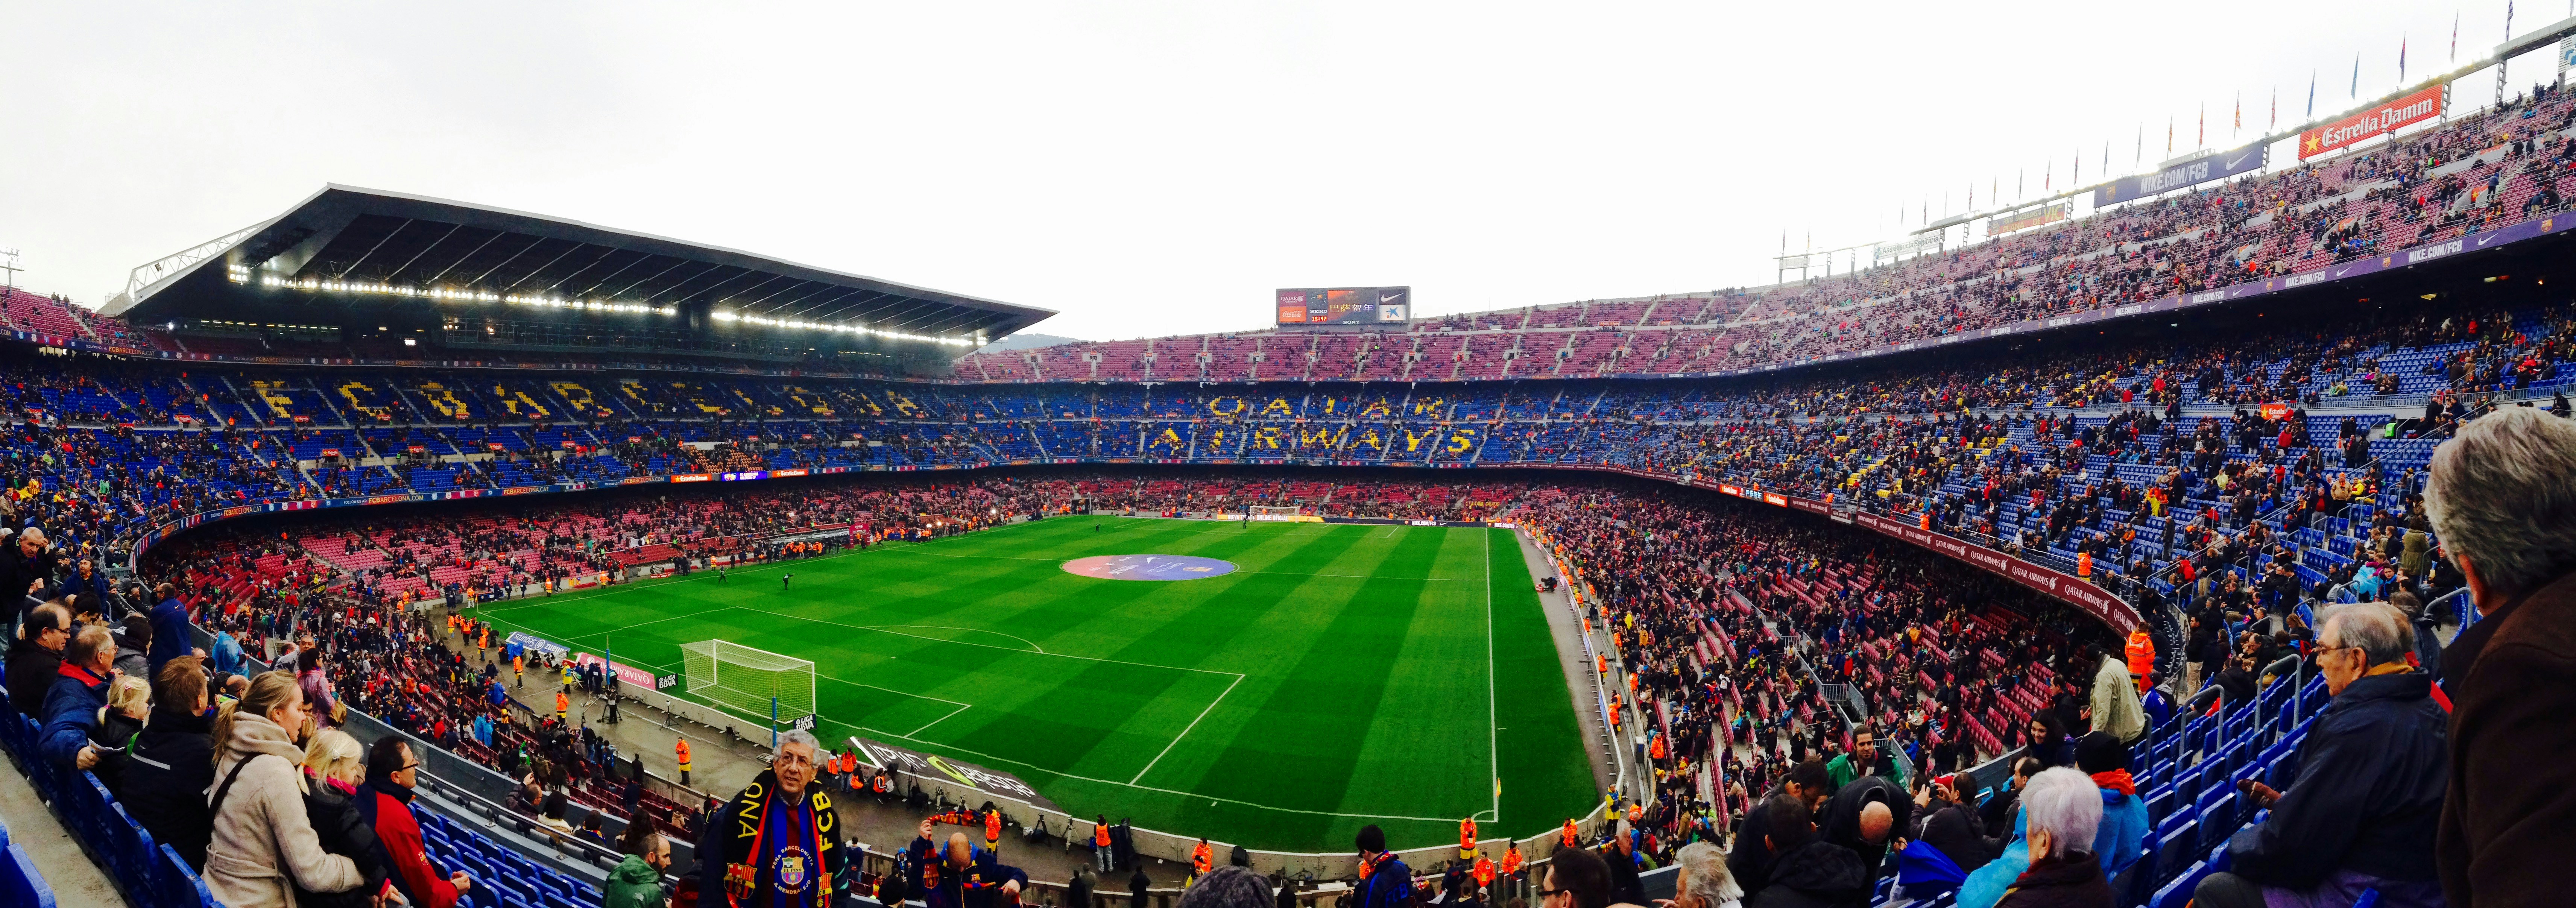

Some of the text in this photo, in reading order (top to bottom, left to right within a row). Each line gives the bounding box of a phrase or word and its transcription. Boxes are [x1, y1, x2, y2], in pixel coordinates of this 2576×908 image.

[2322, 98, 2433, 147] Estrella Damm
[2140, 161, 2208, 194] NIKE.COM/FCB
[2003, 222, 2024, 232] PLANA
[2044, 204, 2063, 222] VIC
[2409, 240, 2463, 263] NIKE.COM/FCB
[2285, 271, 2325, 287] NIKE.COM/FCB
[2193, 291, 2224, 303] NIKE.COM/FCB
[1331, 304, 1373, 312] 巴萨贺年
[2115, 306, 2142, 316] NIKE.COM/FCB
[2049, 317, 2071, 326] NIKE.COM/FCB
[109, 346, 155, 355] FCBARCELONA.CAT
[369, 495, 424, 504] FCBARCELONA.COM
[224, 506, 261, 516] FCBARCELONA.CAT
[1915, 533, 1926, 541] AIRWAYS
[1947, 543, 1960, 553] AIRWAYS
[1971, 551, 2000, 567] QATAR AIRWAYS
[2012, 566, 2049, 586] QATAR AIRWAYS
[2065, 584, 2103, 609] QATAR AIRWAYS
[2114, 609, 2125, 626] QATAR
[513, 634, 567, 653] llianz Seguros
[659, 679, 676, 689] BBVA
[796, 721, 814, 731] BBVA
[950, 764, 1035, 798] etisalat
[738, 782, 763, 838] ONA
[812, 791, 833, 852] FCB
[772, 846, 814, 869] PEÑA BARCELONISTA
[773, 879, 811, 895] ALMENDRALEJO
